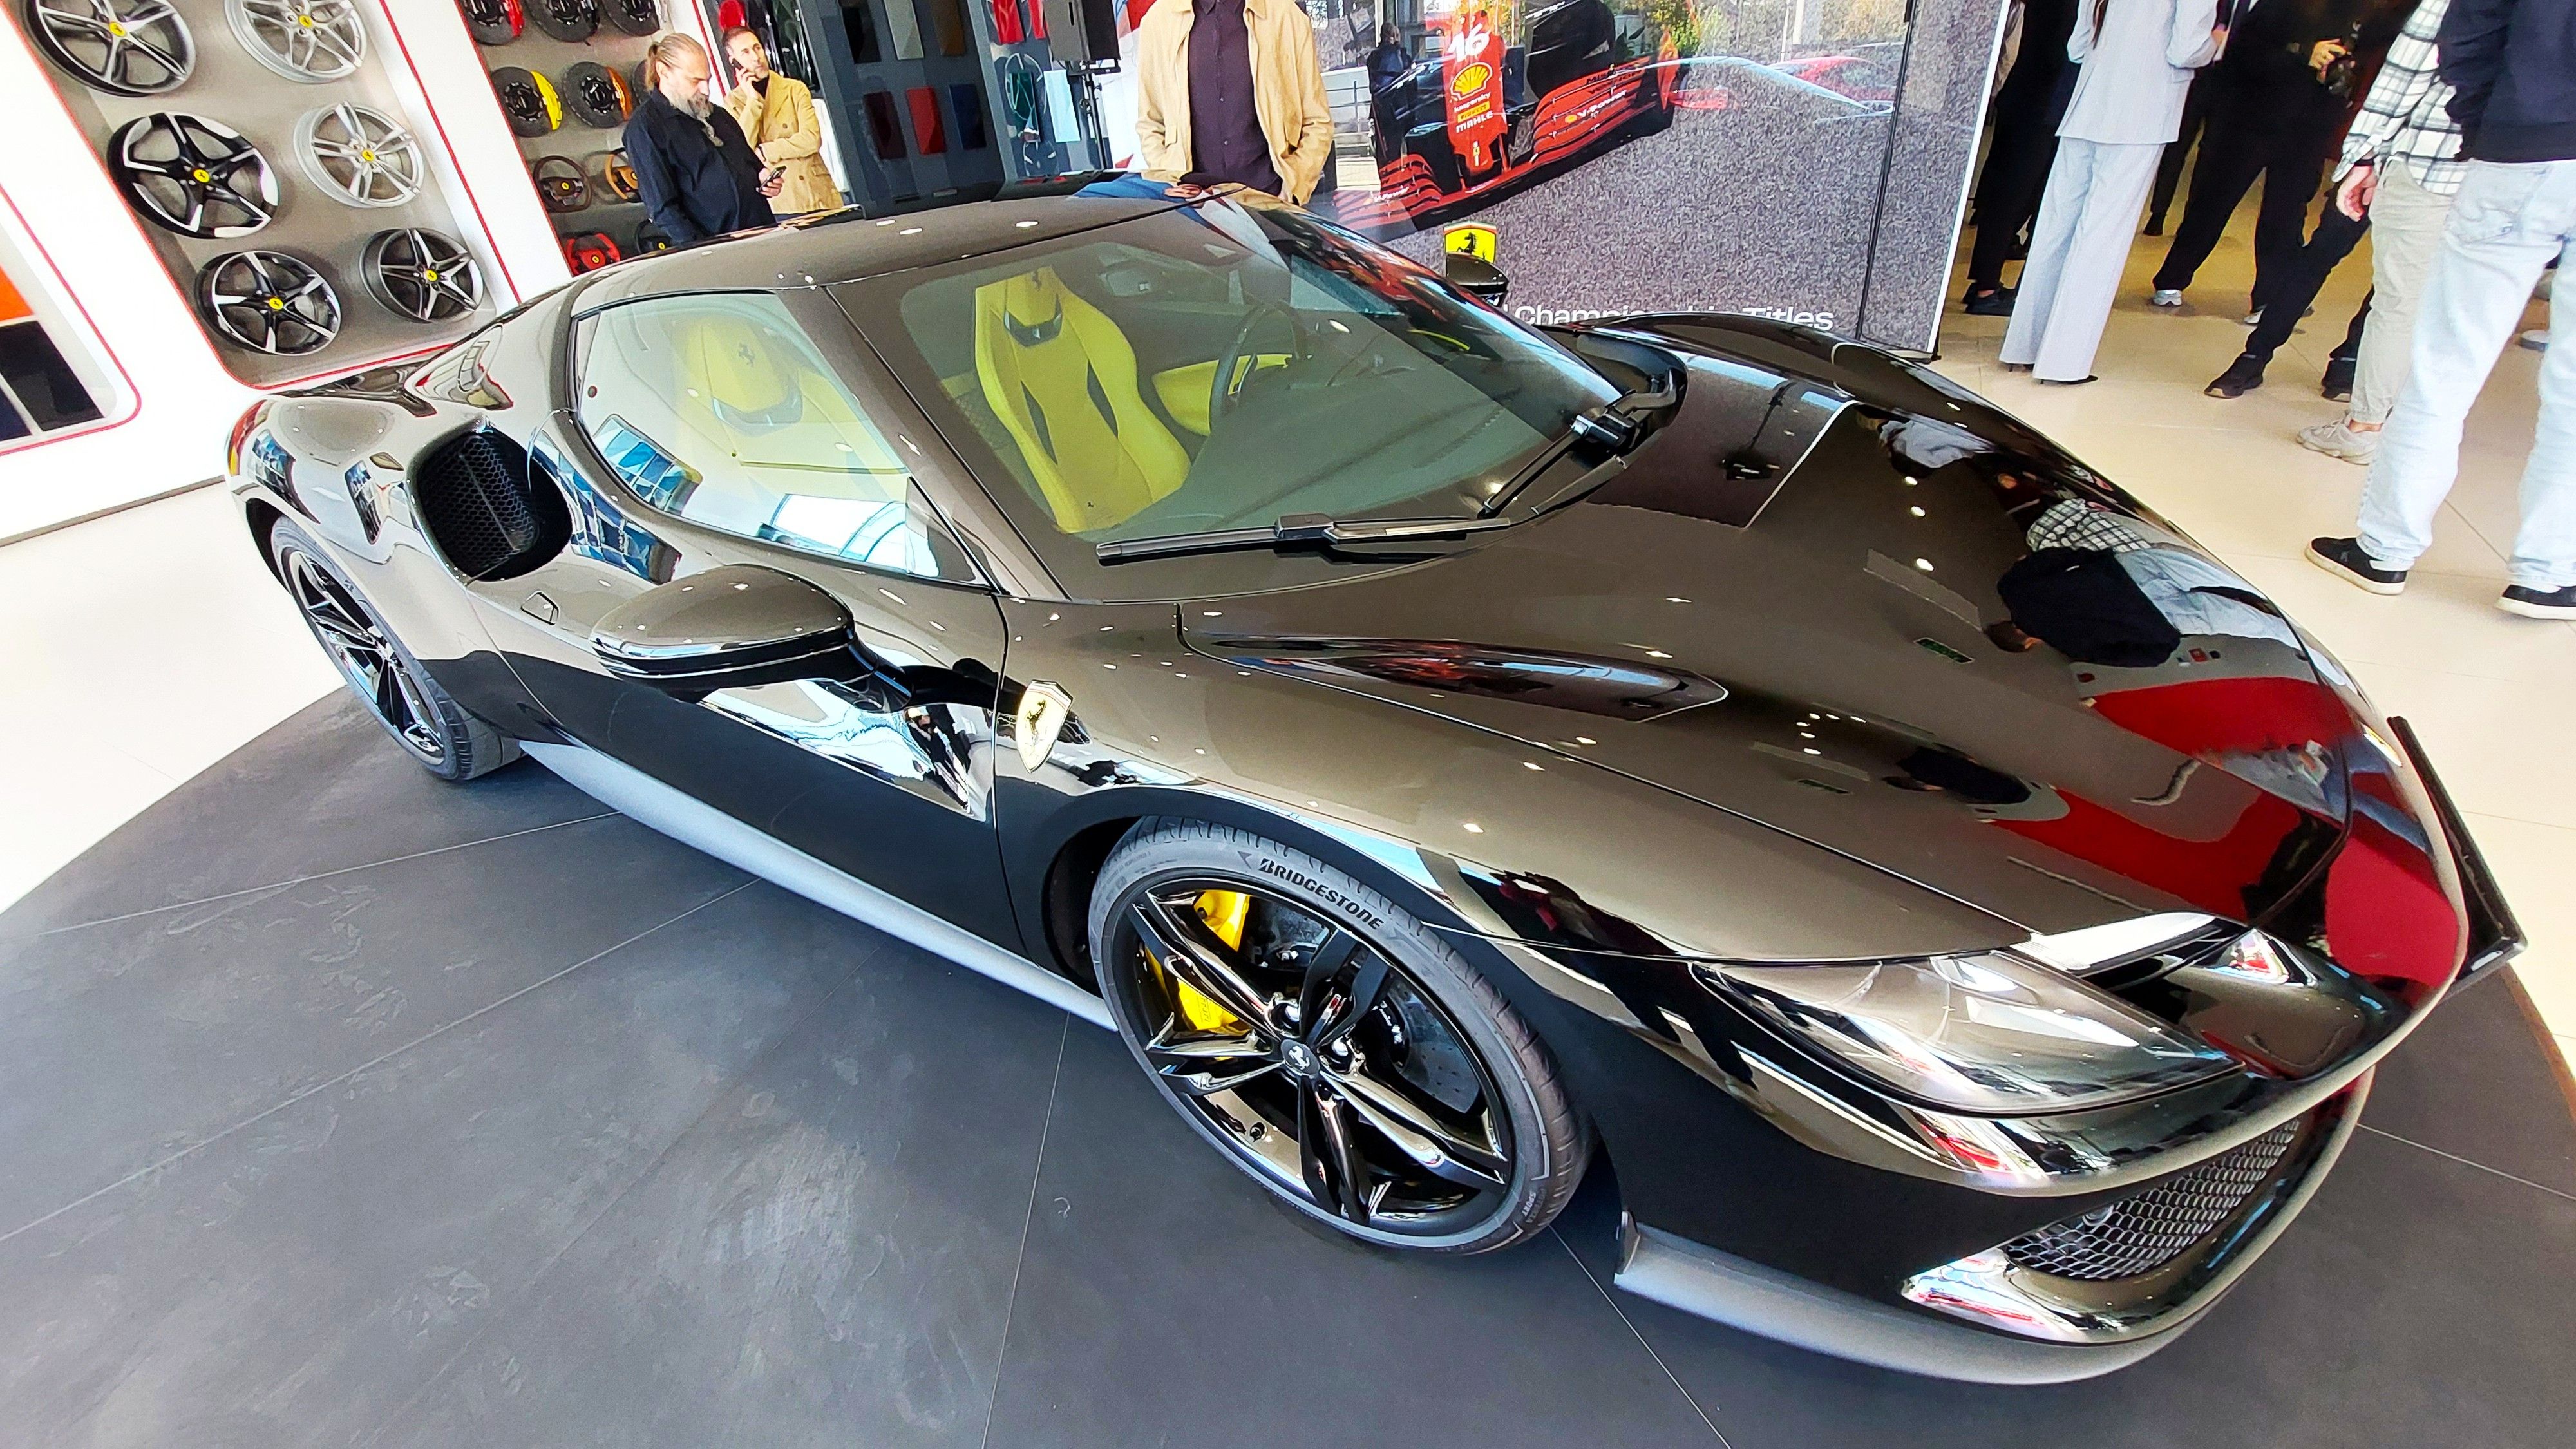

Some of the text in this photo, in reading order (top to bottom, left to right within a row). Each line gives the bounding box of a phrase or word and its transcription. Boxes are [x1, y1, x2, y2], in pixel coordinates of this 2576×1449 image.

[1446, 23, 1492, 62] 16
[1577, 90, 1627, 117] V-Power
[1455, 110, 1493, 133] MAHLE
[1742, 306, 1835, 331] Titles
[1258, 858, 1384, 930] BRIDGESTONE
